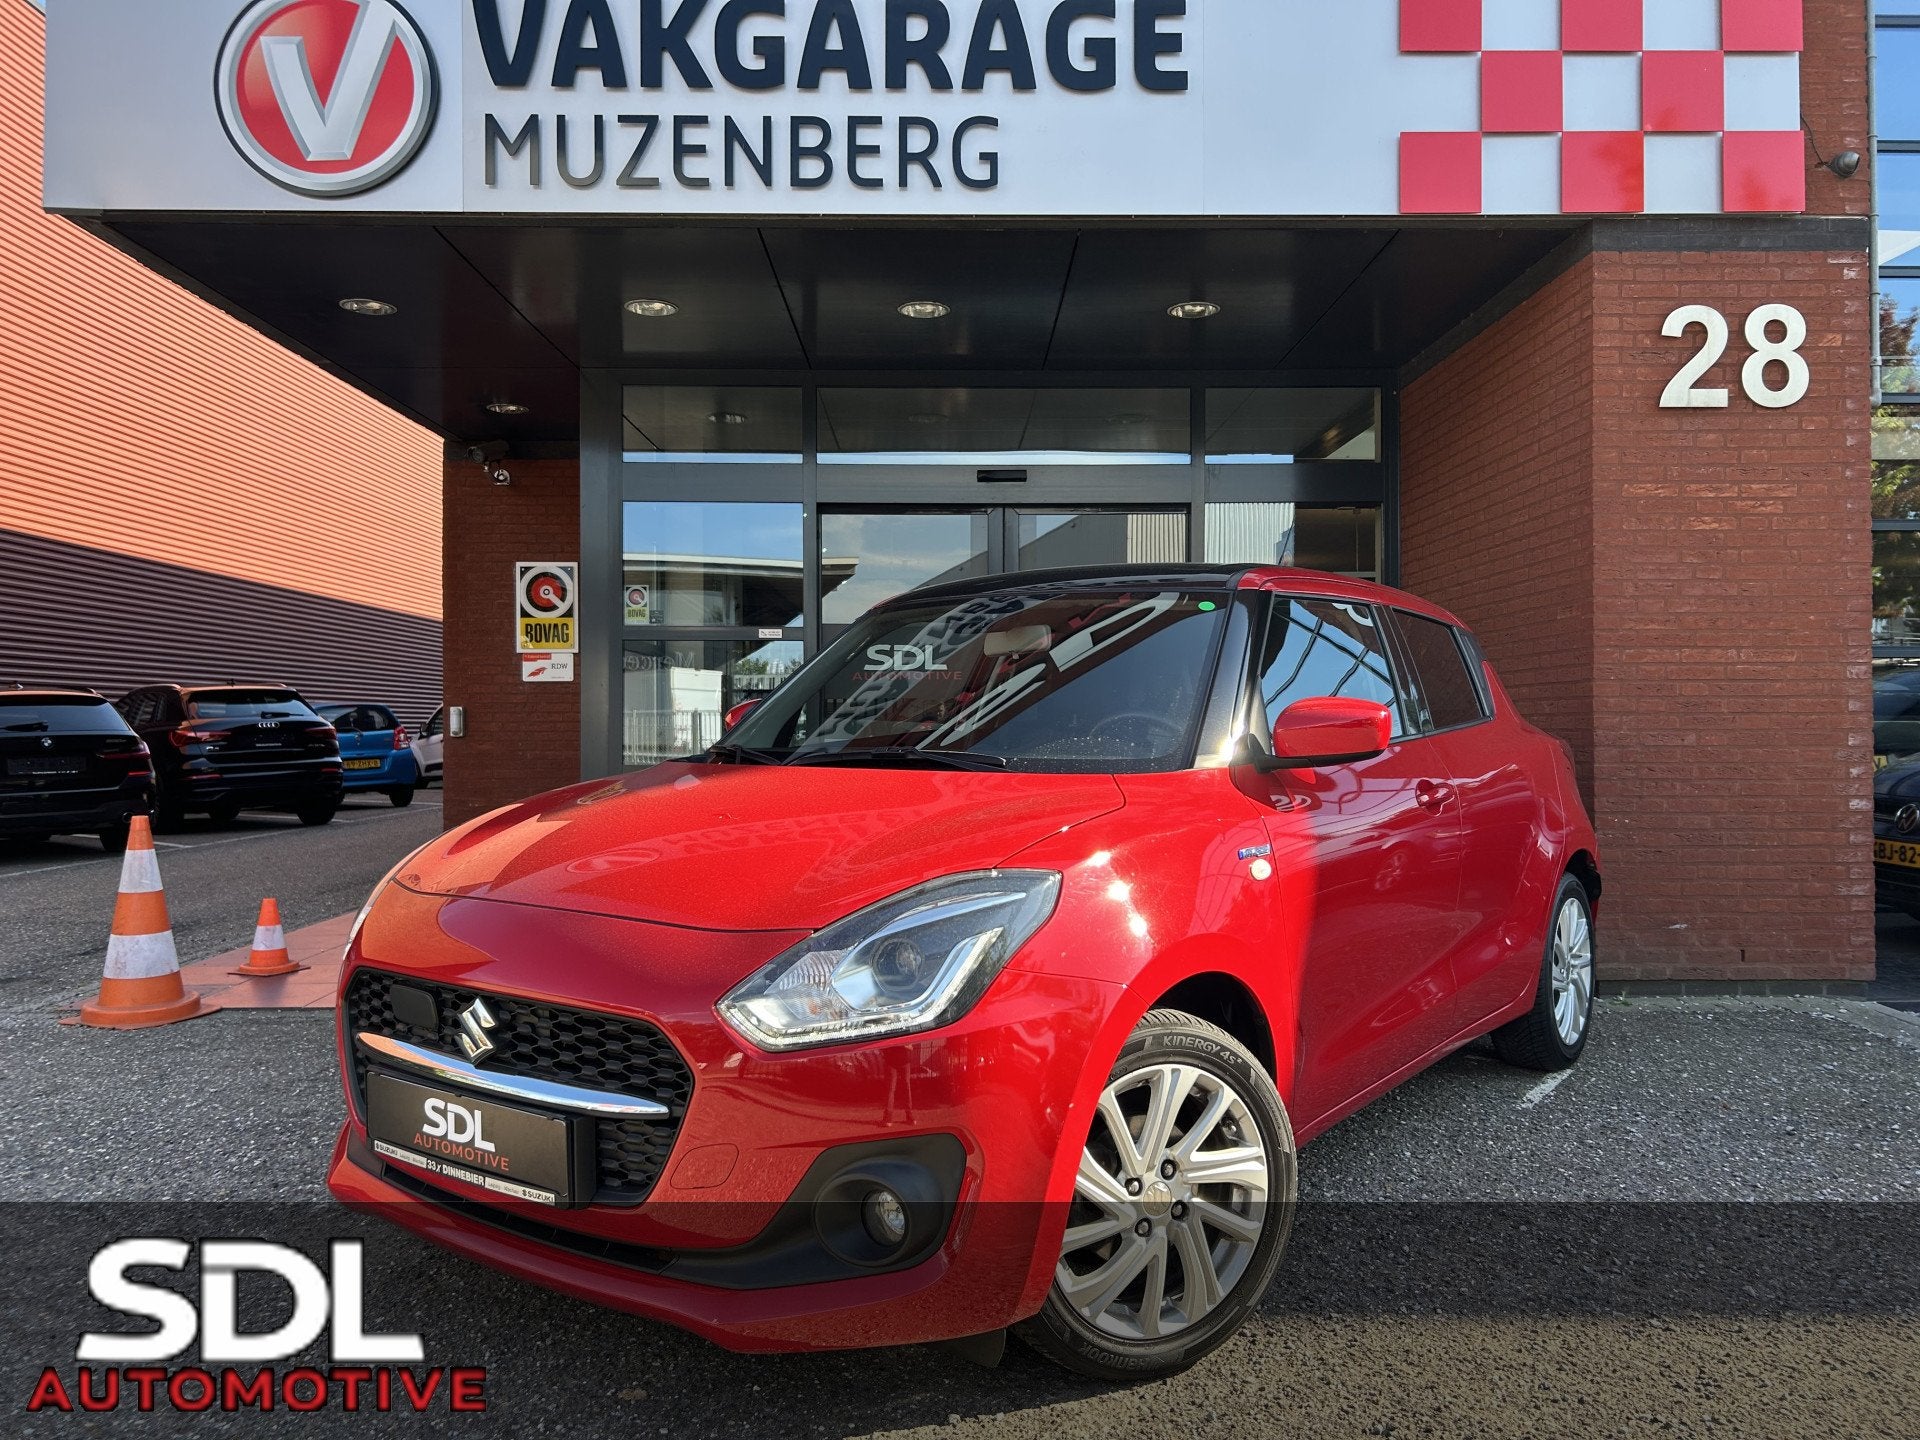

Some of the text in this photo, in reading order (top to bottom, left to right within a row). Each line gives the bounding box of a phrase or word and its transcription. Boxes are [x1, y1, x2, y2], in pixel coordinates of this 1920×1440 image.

[473, 0, 1188, 91] VAKGARAGE
[484, 114, 999, 189] MUZENBERG
[1659, 303, 1809, 408] 28
[525, 623, 569, 643] BOVAG
[853, 671, 962, 680] AUTOMOTIVE
[863, 644, 948, 671] SDL
[1163, 1035, 1221, 1054] KINERGY
[422, 1097, 496, 1152] SDL
[414, 1132, 510, 1171] AUTOMOTIVE
[443, 1164, 485, 1186] DINNEBIER
[527, 1190, 555, 1203] SUZUKI
